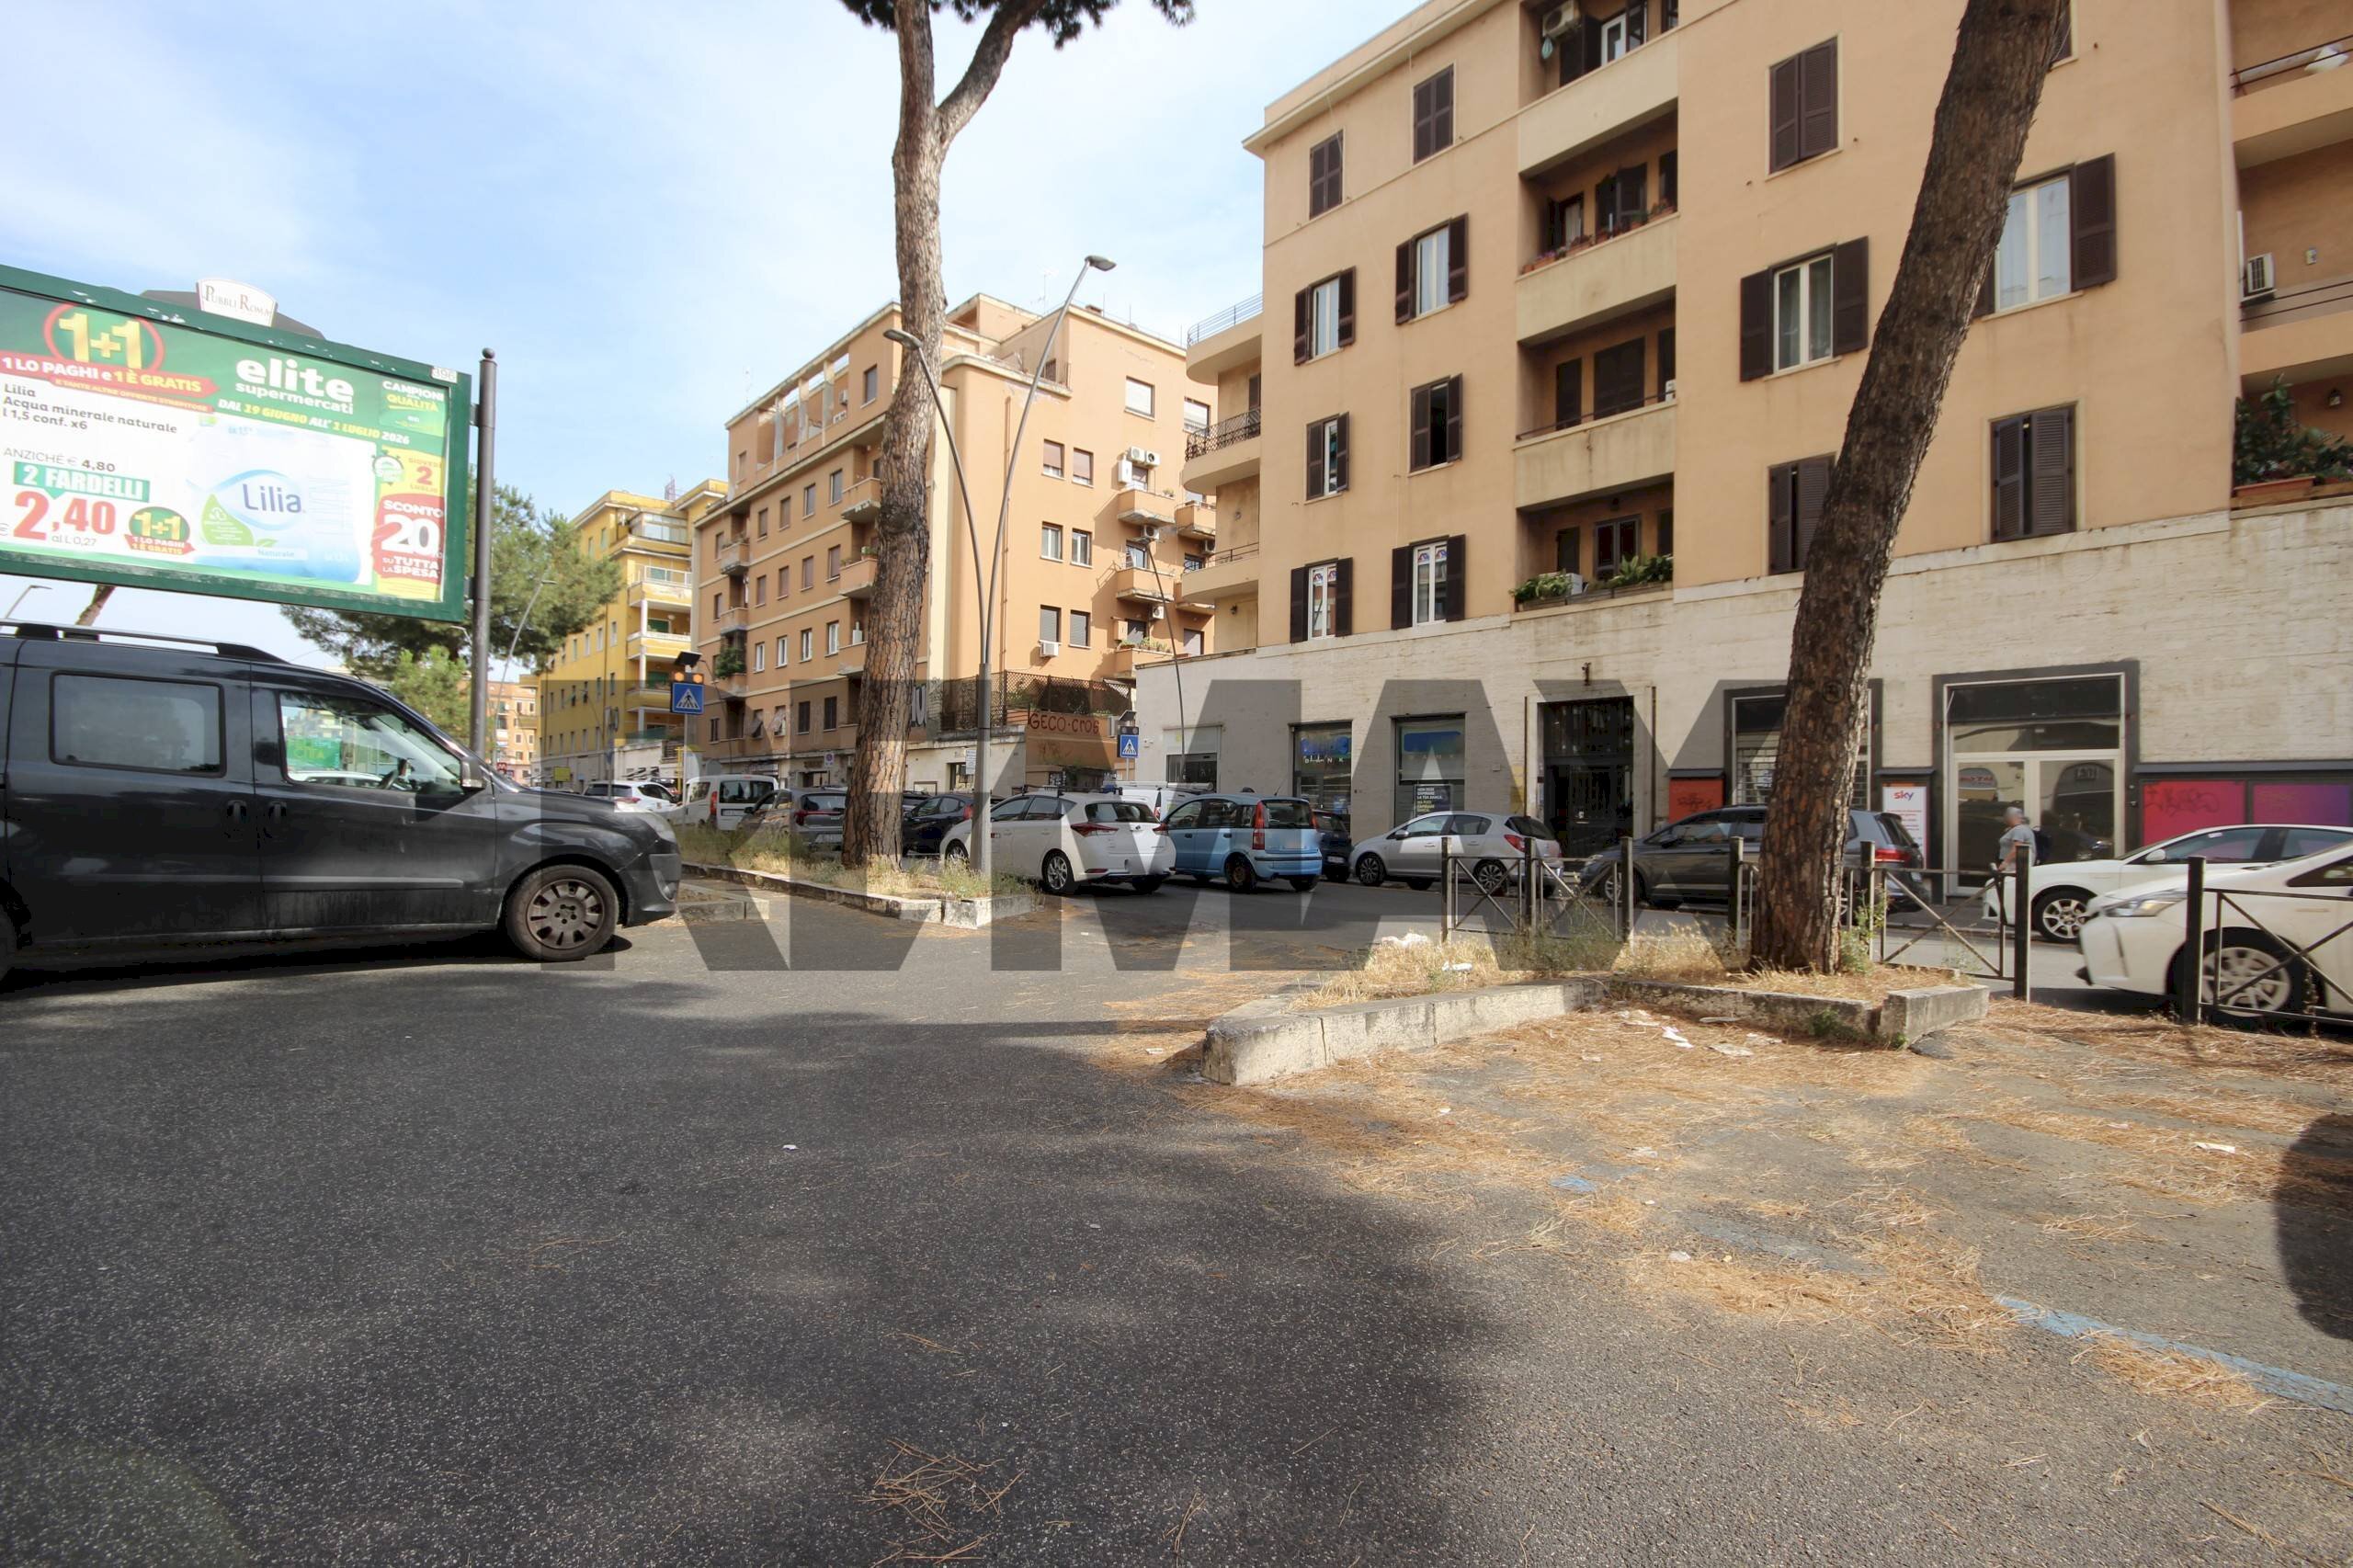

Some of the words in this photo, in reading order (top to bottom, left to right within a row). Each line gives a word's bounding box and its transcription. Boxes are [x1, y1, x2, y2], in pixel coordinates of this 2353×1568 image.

[59, 312, 142, 369] 1+1
[3, 357, 13, 369] 1
[16, 358, 40, 372] LO
[42, 361, 99, 380] PAGHI
[114, 370, 124, 382] 1
[126, 369, 139, 384] È
[141, 374, 202, 392] GRATIS
[236, 358, 355, 403] elite
[4, 383, 36, 398] Lilia
[235, 382, 354, 415] supermercati
[382, 381, 445, 402] CAMPIONI
[4, 396, 49, 413] Acqua
[52, 405, 115, 423] minerale
[118, 415, 177, 434] naturale
[11, 409, 30, 422] 1,5
[33, 413, 67, 427] conf.
[71, 420, 88, 430] x6
[218, 399, 242, 412] DAL
[244, 403, 261, 416] 19
[263, 407, 308, 425] GIUGNO
[341, 423, 381, 439] LUGLIO
[381, 431, 410, 445] 2026
[82, 460, 116, 472] 4,80
[416, 466, 433, 486] 2
[23, 465, 39, 485] 2
[46, 470, 144, 501] FARDELLI
[243, 483, 302, 514] Lilia
[383, 500, 443, 518] SCONTO
[13, 491, 117, 540] 2,40
[134, 511, 181, 540] 1+1
[394, 555, 439, 570] TUTTA
[394, 565, 439, 579] SPESA
[1893, 790, 1914, 801] sky
